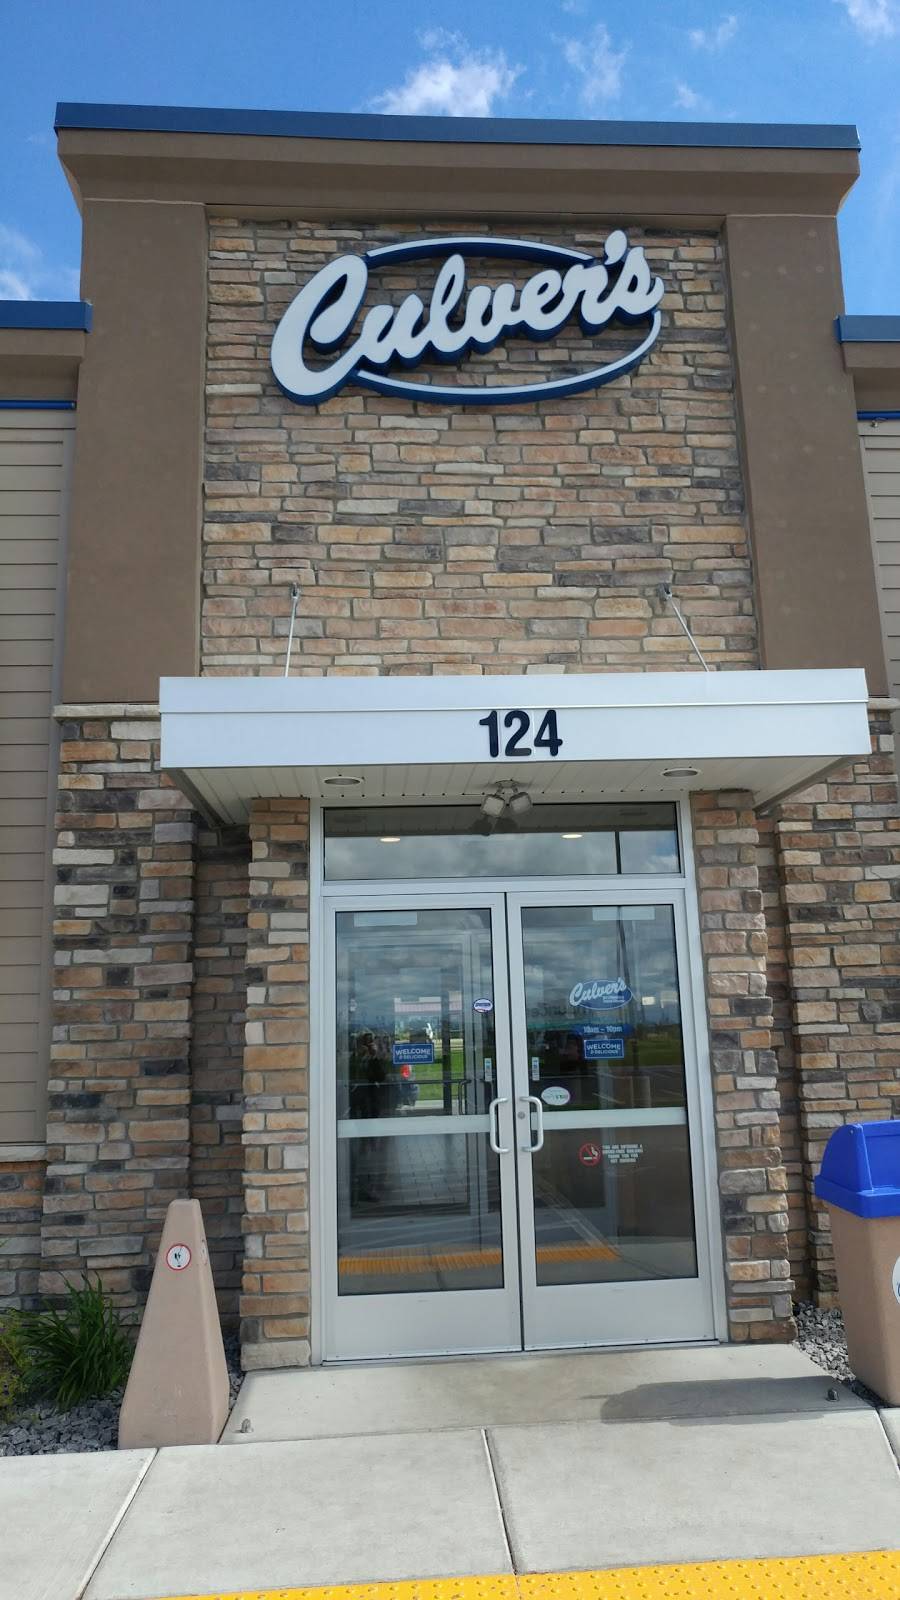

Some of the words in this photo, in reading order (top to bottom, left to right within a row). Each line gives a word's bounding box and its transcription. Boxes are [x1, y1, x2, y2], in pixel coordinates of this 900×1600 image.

[270, 230, 664, 398] Culver's
[479, 709, 563, 758] 124
[569, 977, 627, 1007] Culver's
[395, 1048, 431, 1056] WELCOME
